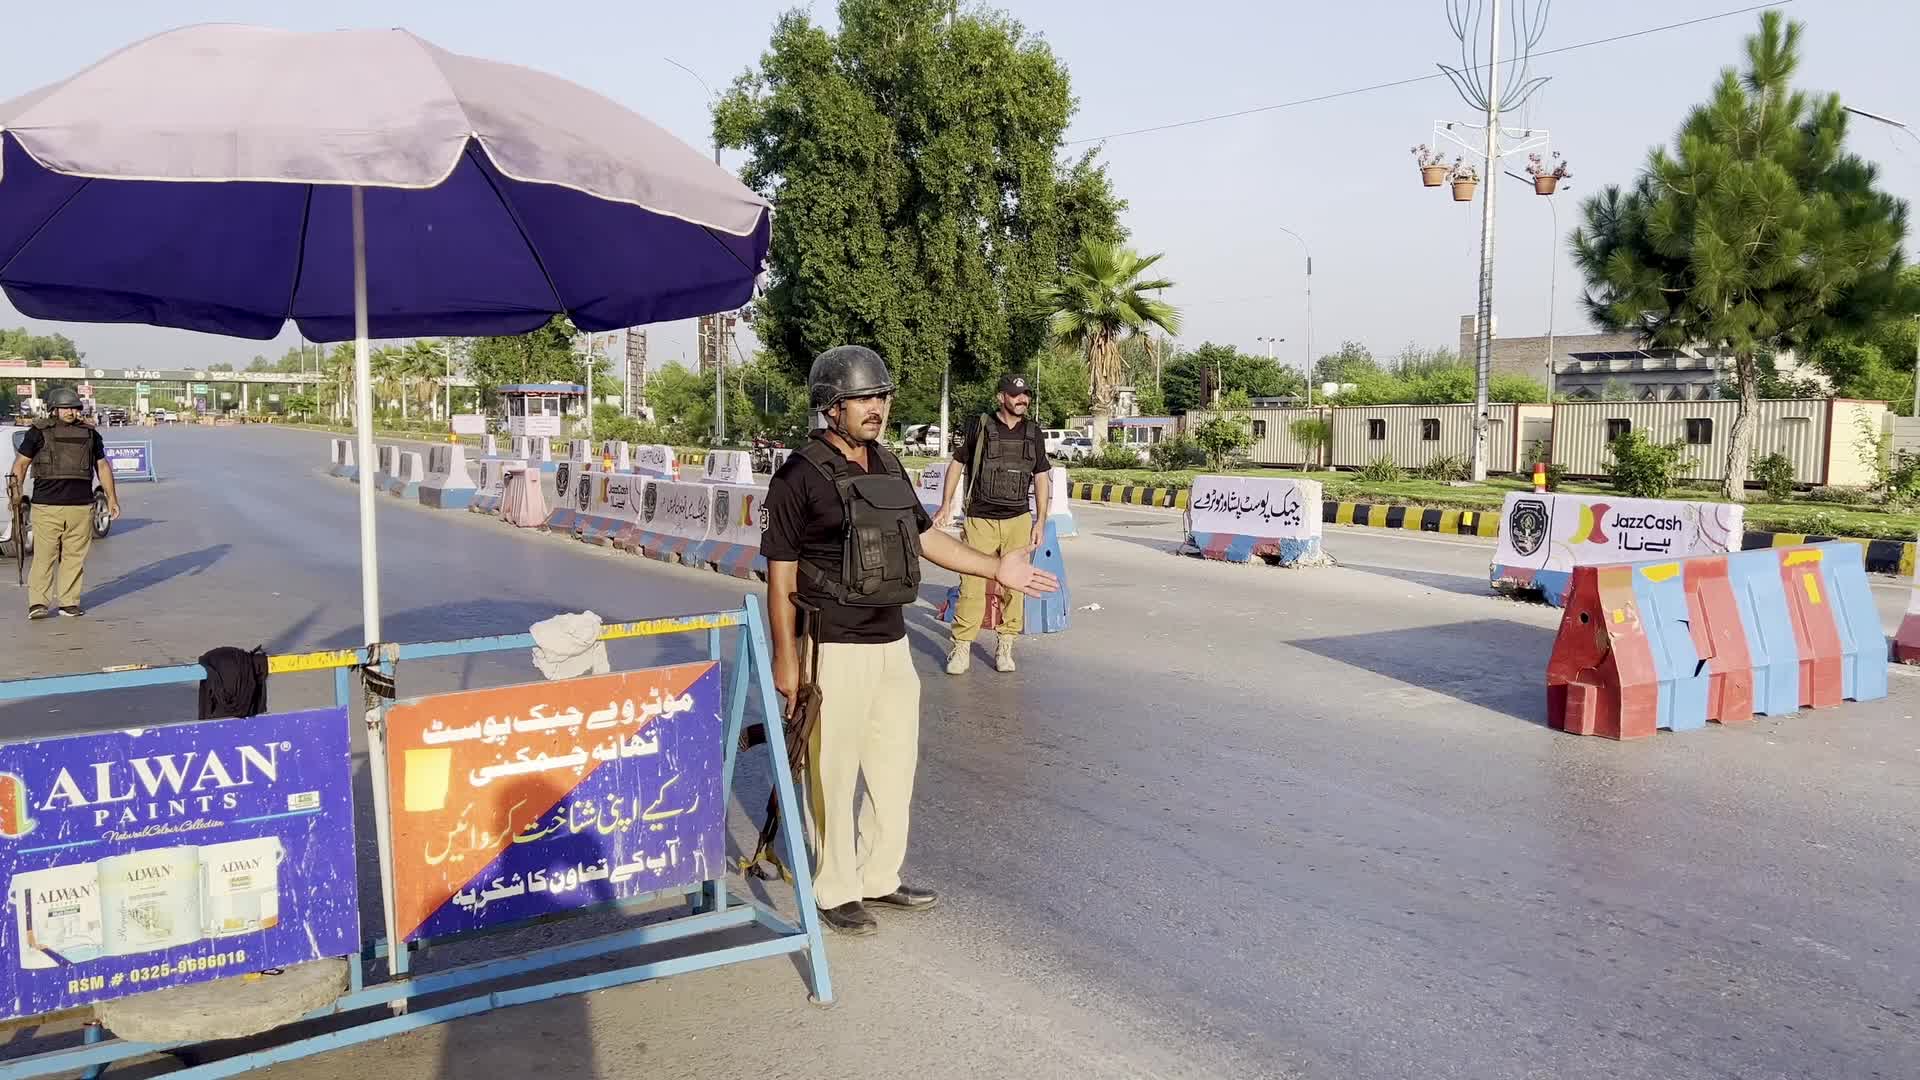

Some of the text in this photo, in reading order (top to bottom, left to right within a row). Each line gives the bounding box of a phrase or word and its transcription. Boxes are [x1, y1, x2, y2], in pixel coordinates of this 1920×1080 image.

[124, 370, 161, 379] M-TAG
[1240, 490, 1270, 523] پوسٹ
[1271, 487, 1300, 526] چیک
[1612, 513, 1682, 531] JazzCash
[422, 715, 512, 745] پوسٹ
[513, 703, 585, 737] چیک
[469, 728, 659, 787] تھانہ چمکنی
[94, 791, 237, 827] PAINTS
[126, 865, 171, 883] ALWAN
[220, 858, 260, 874] ALWAN
[452, 838, 680, 910] آپ کے تعاون کا شکریہ
[36, 885, 91, 905] ALWAN
[69, 975, 104, 994] RSM
[130, 949, 246, 983] 0325-9696018
